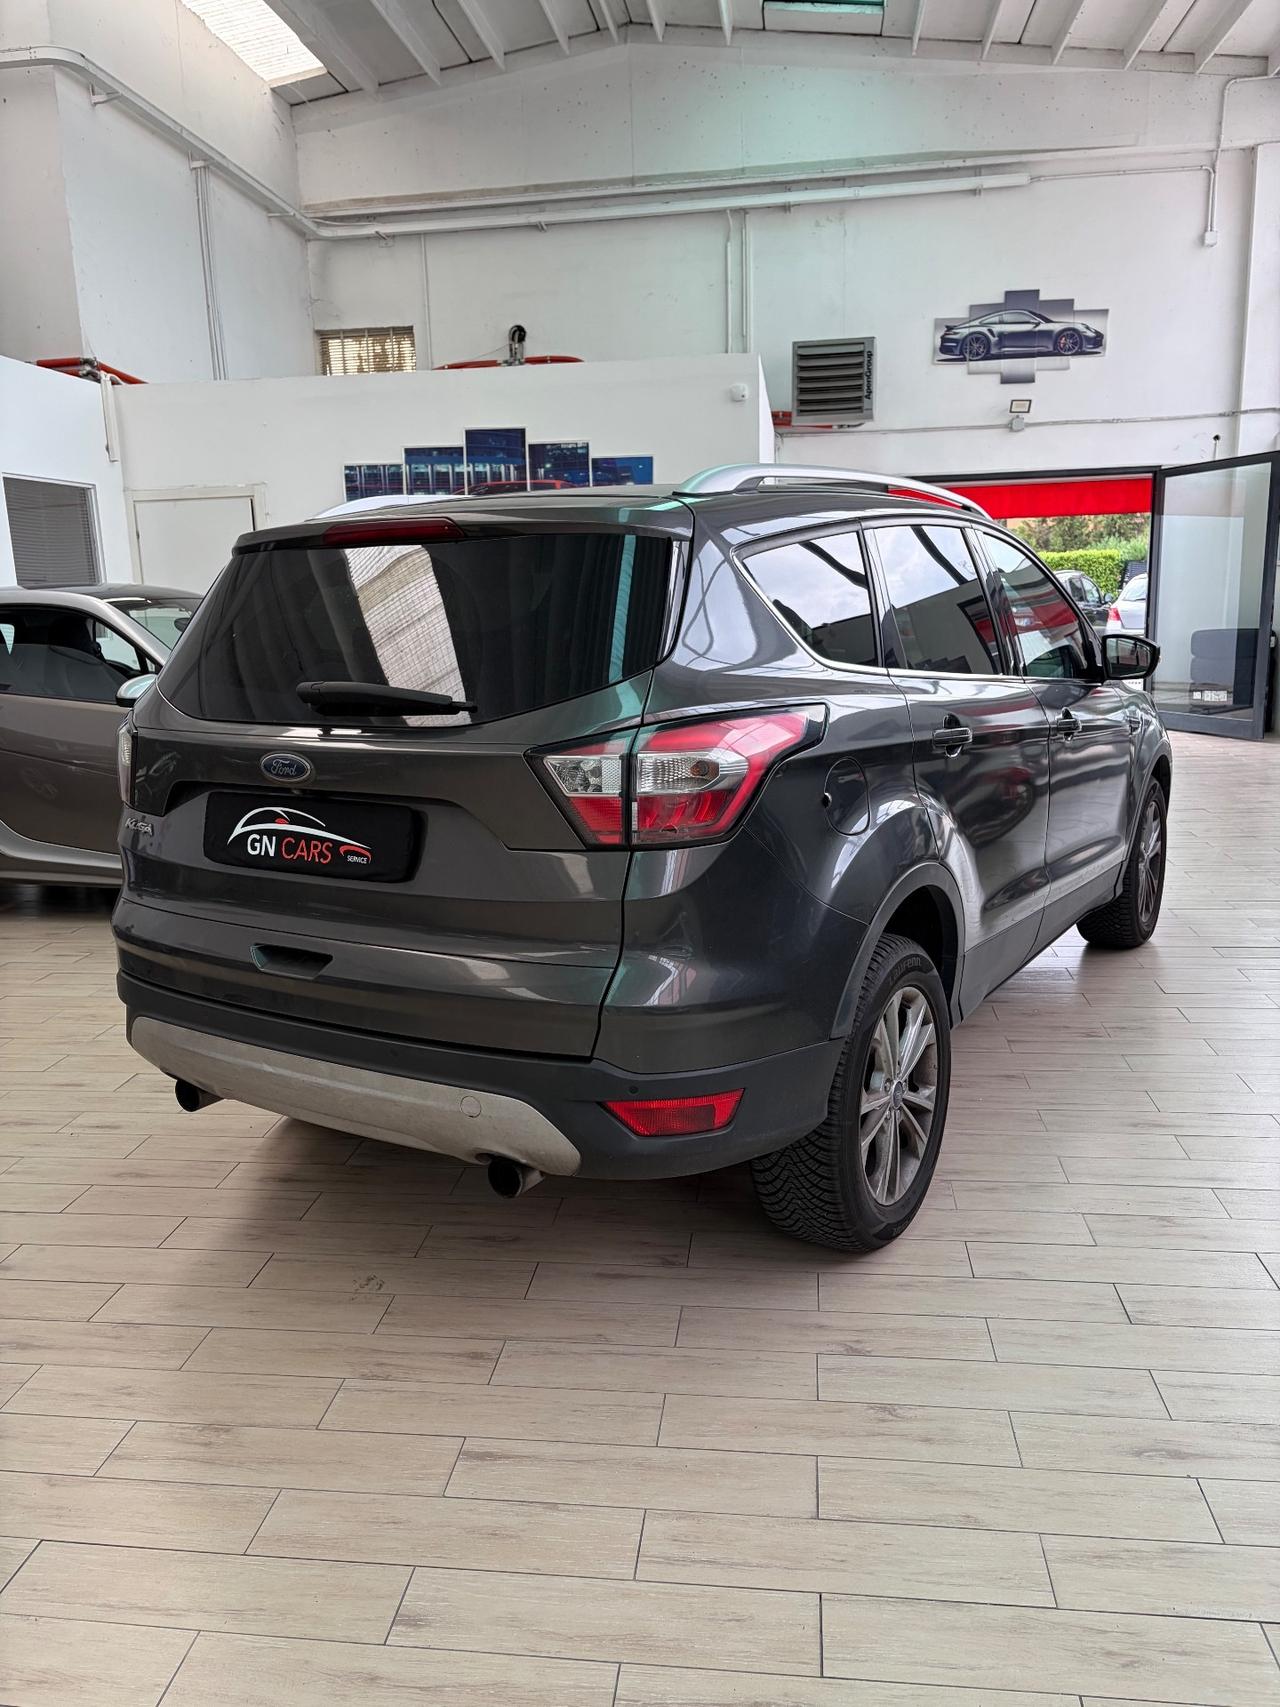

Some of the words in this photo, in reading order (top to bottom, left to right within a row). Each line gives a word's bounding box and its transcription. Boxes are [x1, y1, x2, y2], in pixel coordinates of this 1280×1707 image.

[864, 350, 873, 400] ApenGroup
[270, 758, 298, 776] Ford
[247, 833, 277, 857] GN
[281, 836, 334, 865] CARS
[346, 854, 369, 865] SERVICE
